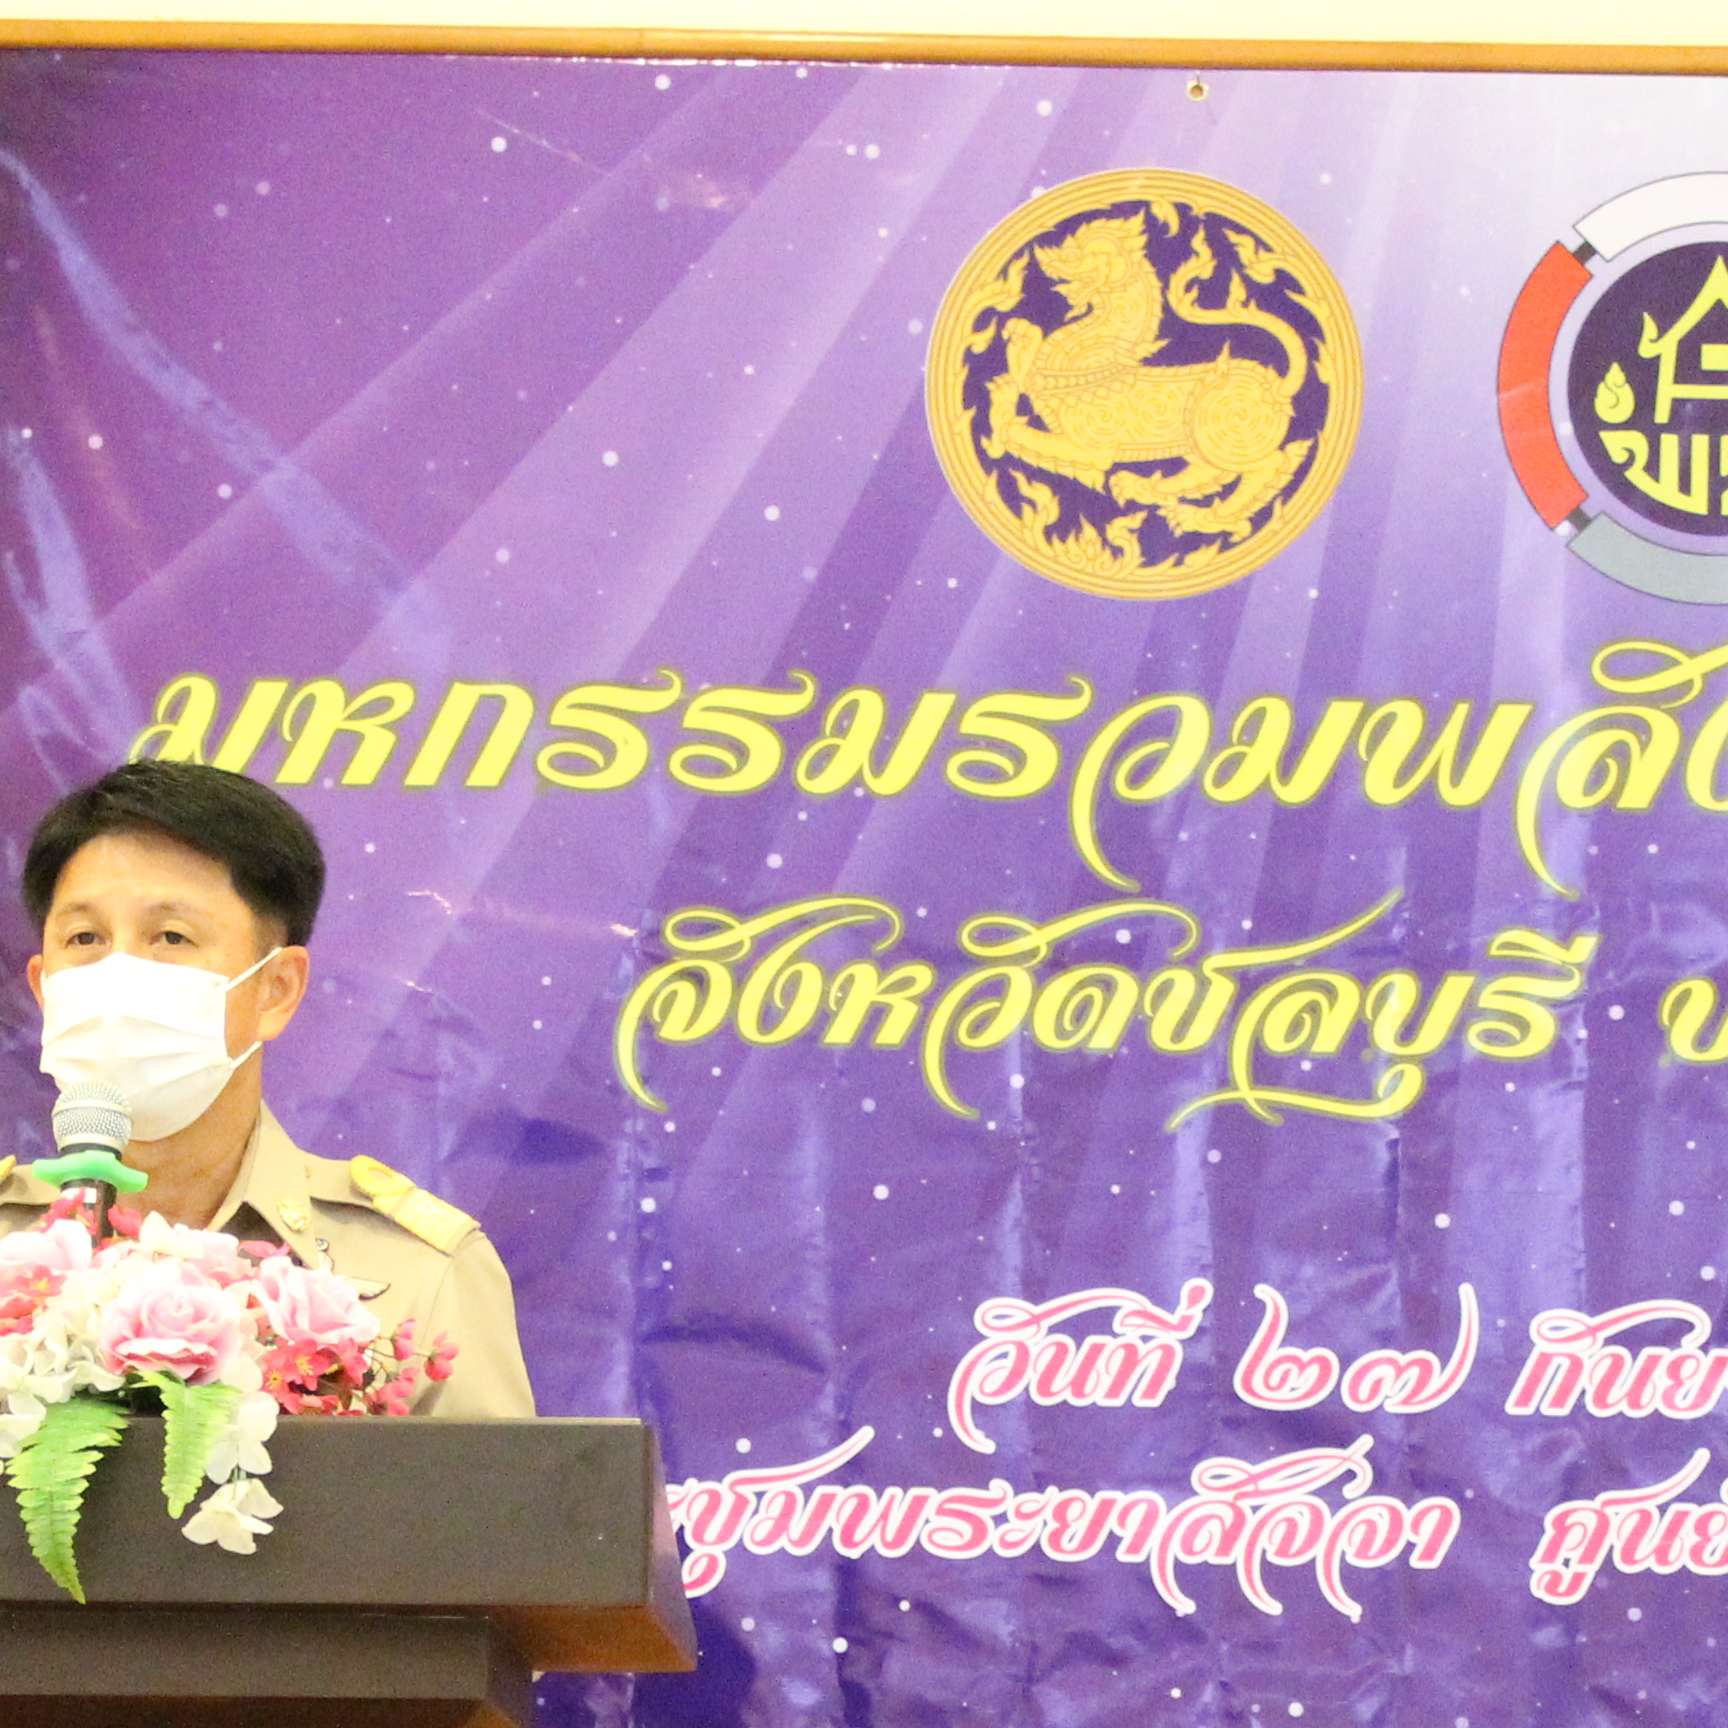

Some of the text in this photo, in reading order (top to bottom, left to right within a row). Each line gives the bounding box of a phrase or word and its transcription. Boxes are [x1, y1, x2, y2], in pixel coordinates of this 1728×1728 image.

[615, 894, 1598, 1124] จังหวัดชลบุรี
[948, 1278, 1213, 1453] วันที่
[1234, 1283, 1478, 1413] ๒๗
